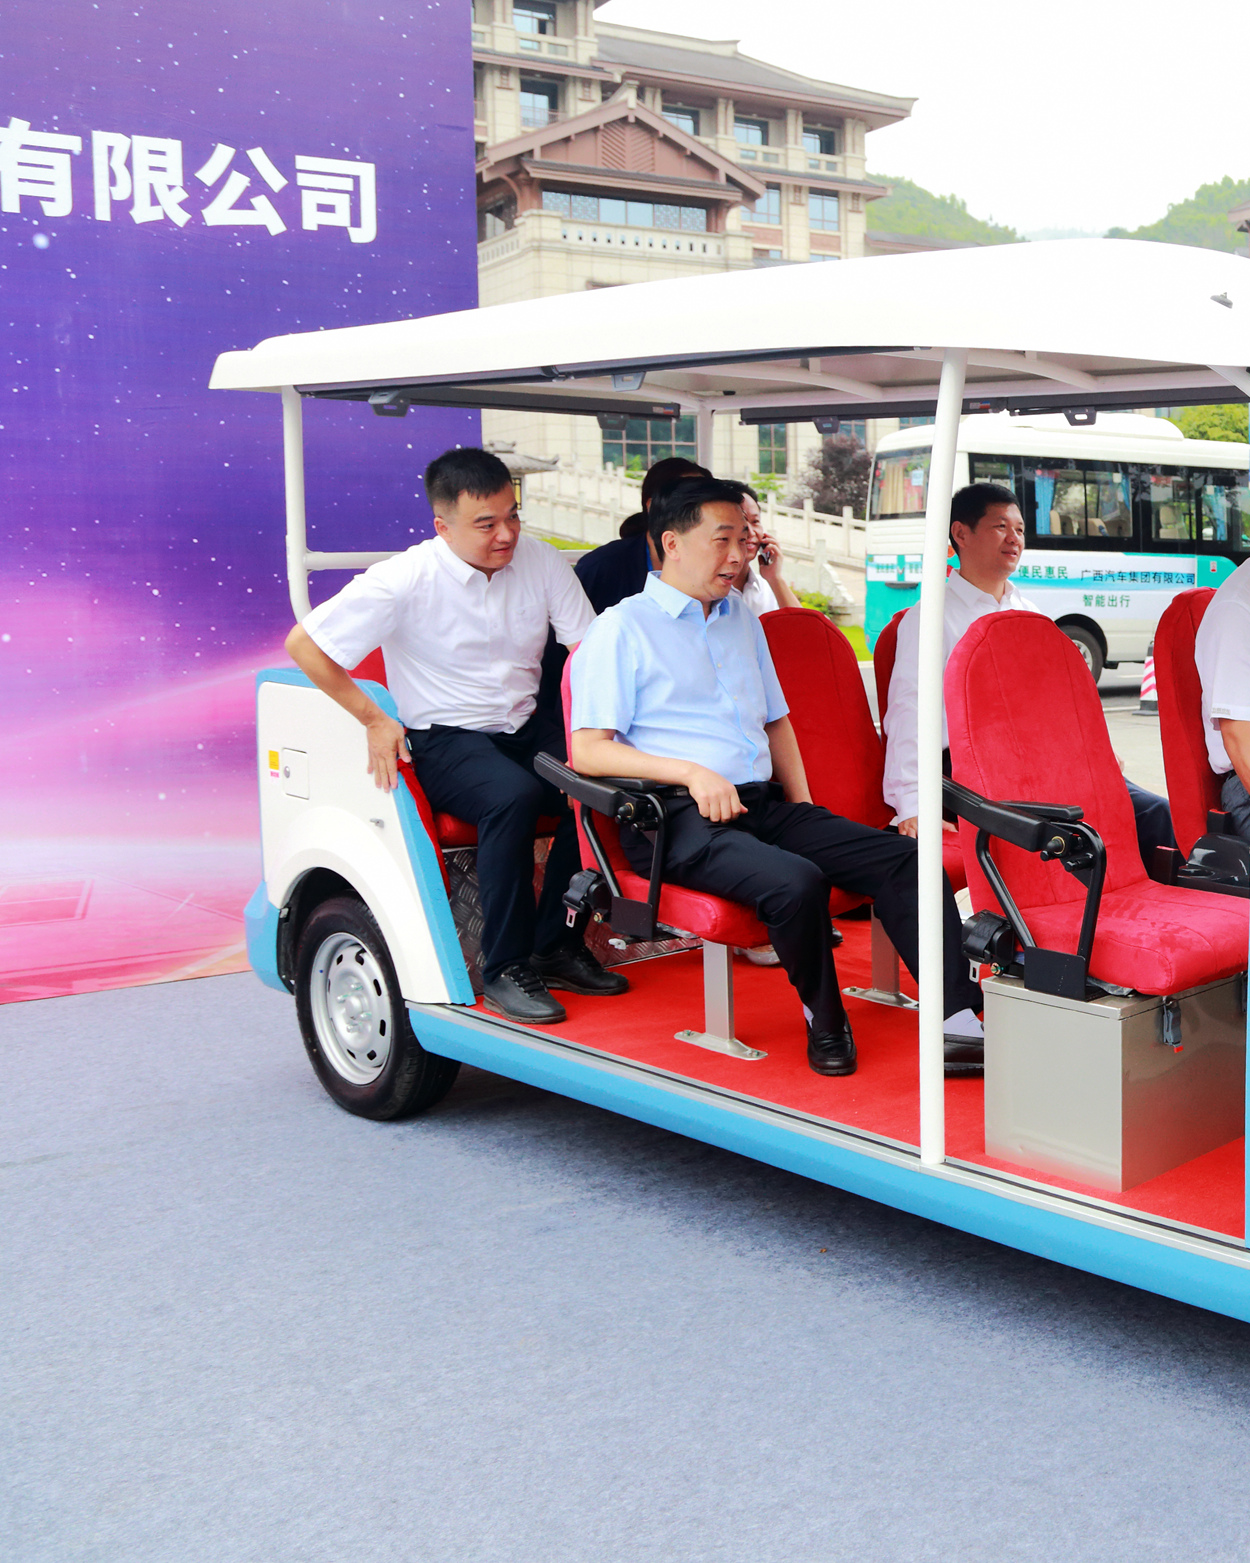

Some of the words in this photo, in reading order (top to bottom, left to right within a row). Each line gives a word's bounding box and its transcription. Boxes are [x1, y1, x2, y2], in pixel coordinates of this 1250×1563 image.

[0, 116, 378, 244] 有限公司
[1018, 565, 1069, 579] 便民惠民
[1080, 569, 1196, 585] 广西汽车集团有限公司
[1083, 594, 1131, 608] 智能出行
